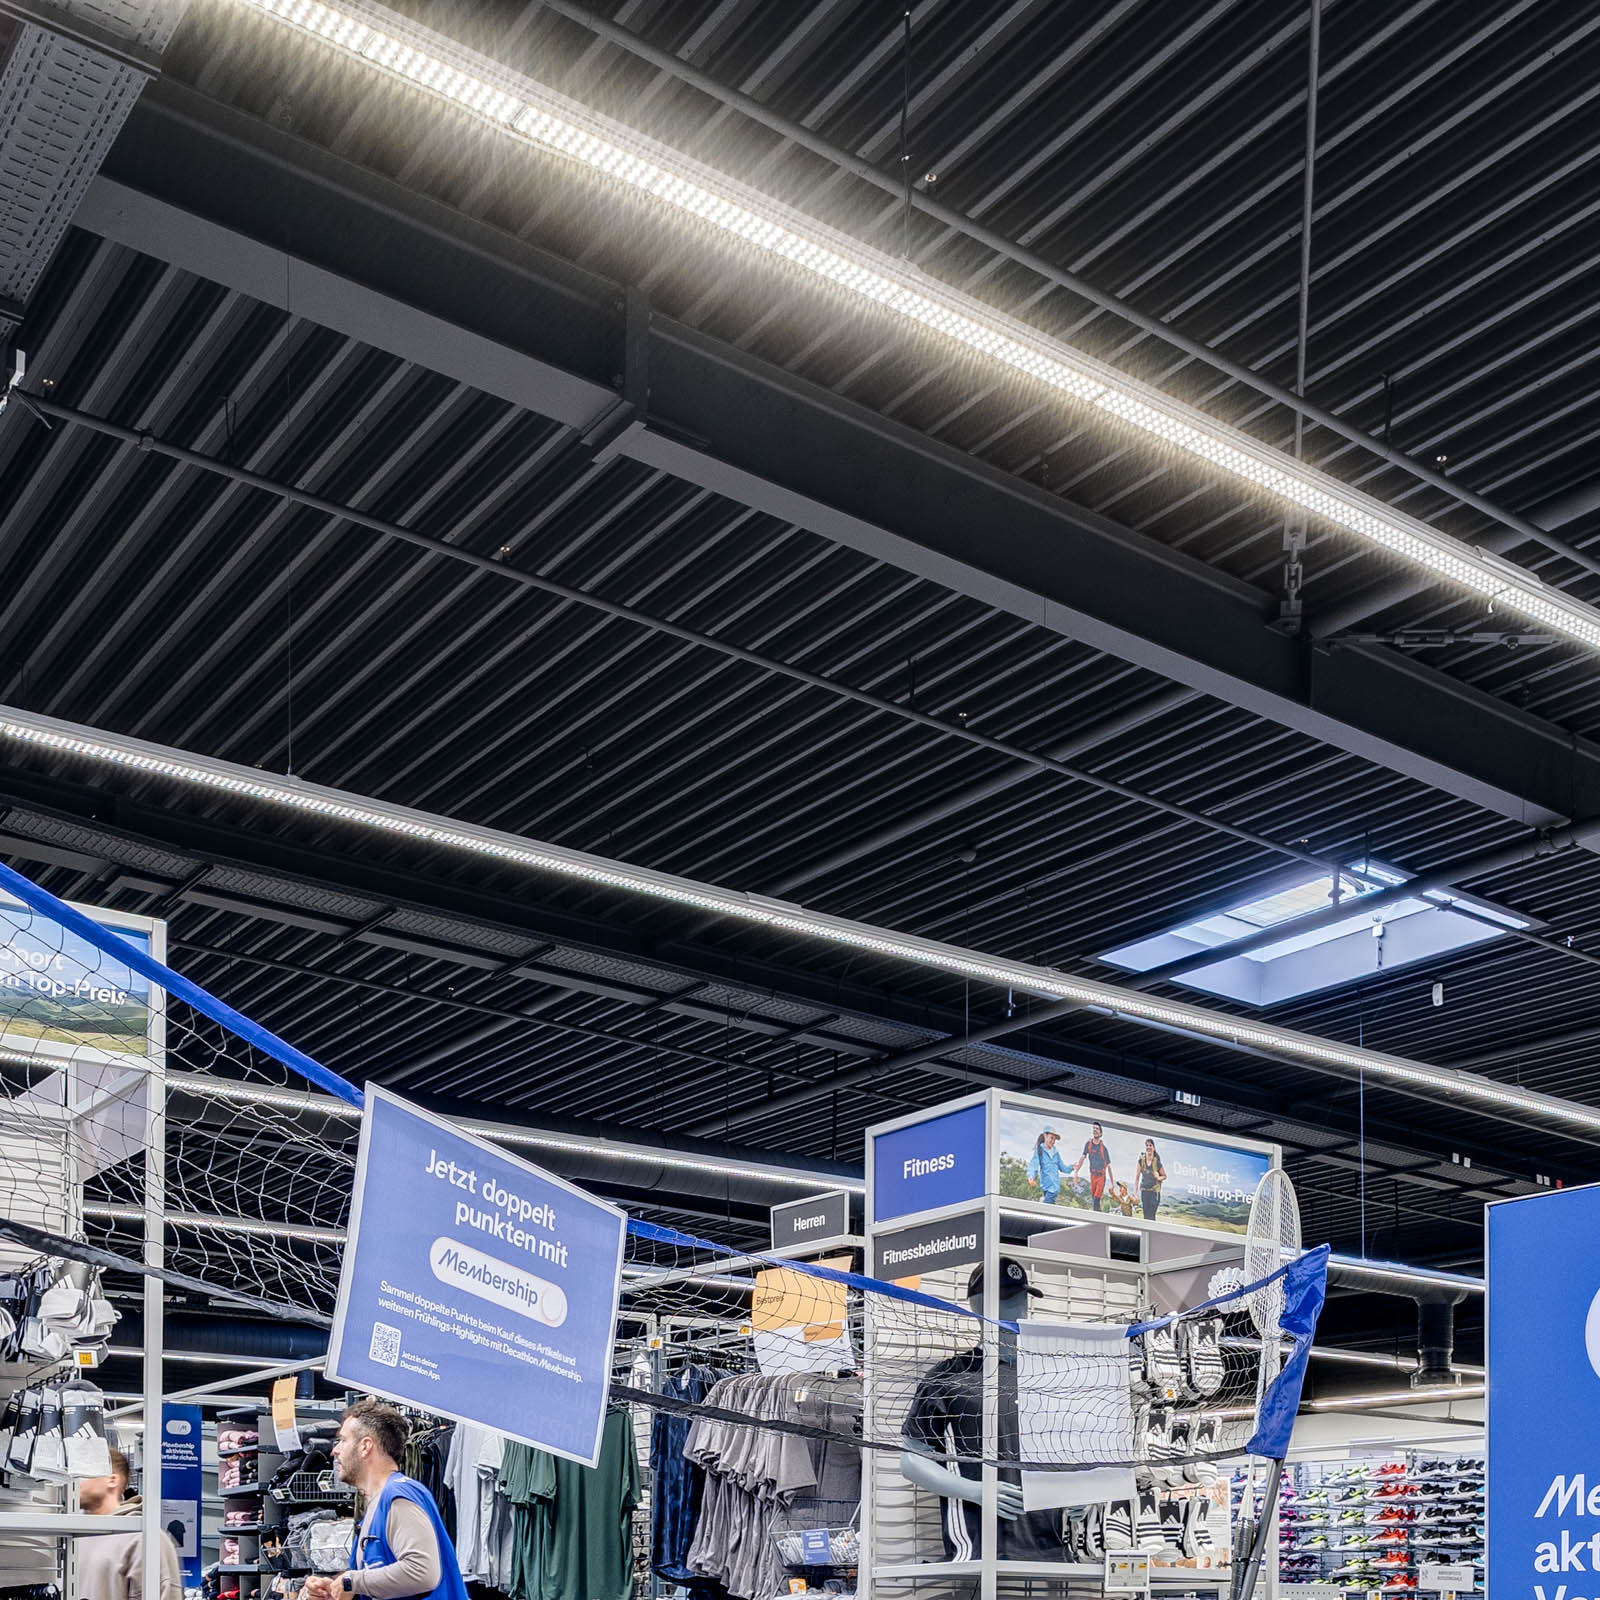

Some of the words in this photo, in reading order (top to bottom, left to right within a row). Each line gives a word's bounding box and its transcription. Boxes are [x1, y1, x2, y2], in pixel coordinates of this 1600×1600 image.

[20, 968, 128, 1006] Top-Preis
[903, 1152, 955, 1179] Fitness
[1174, 1160, 1199, 1177] Dein
[1199, 1165, 1232, 1185] Sport
[425, 1149, 477, 1194] Jetzt
[482, 1179, 556, 1232] doppelt
[1187, 1183, 1211, 1197] zum
[1209, 1184, 1255, 1205] Top-Prei
[455, 1200, 537, 1254] punkten
[538, 1238, 570, 1269] mit
[793, 1213, 826, 1232] Herren
[883, 1233, 977, 1265] Fitnessbekleidung
[438, 1248, 539, 1308] Membership
[378, 1297, 415, 1319] weiteren
[414, 1310, 490, 1348] Frühlings-Highlights
[489, 1340, 503, 1353] mit
[502, 1343, 539, 1367] Decathlon
[537, 1356, 584, 1384] Membership.
[380, 1280, 415, 1301] Sammel
[414, 1292, 451, 1317] doppelte
[450, 1308, 478, 1328] Punkte
[478, 1317, 498, 1334] beim
[496, 1327, 515, 1343] Kauf
[513, 1333, 537, 1352] dieses
[562, 1353, 576, 1368] und
